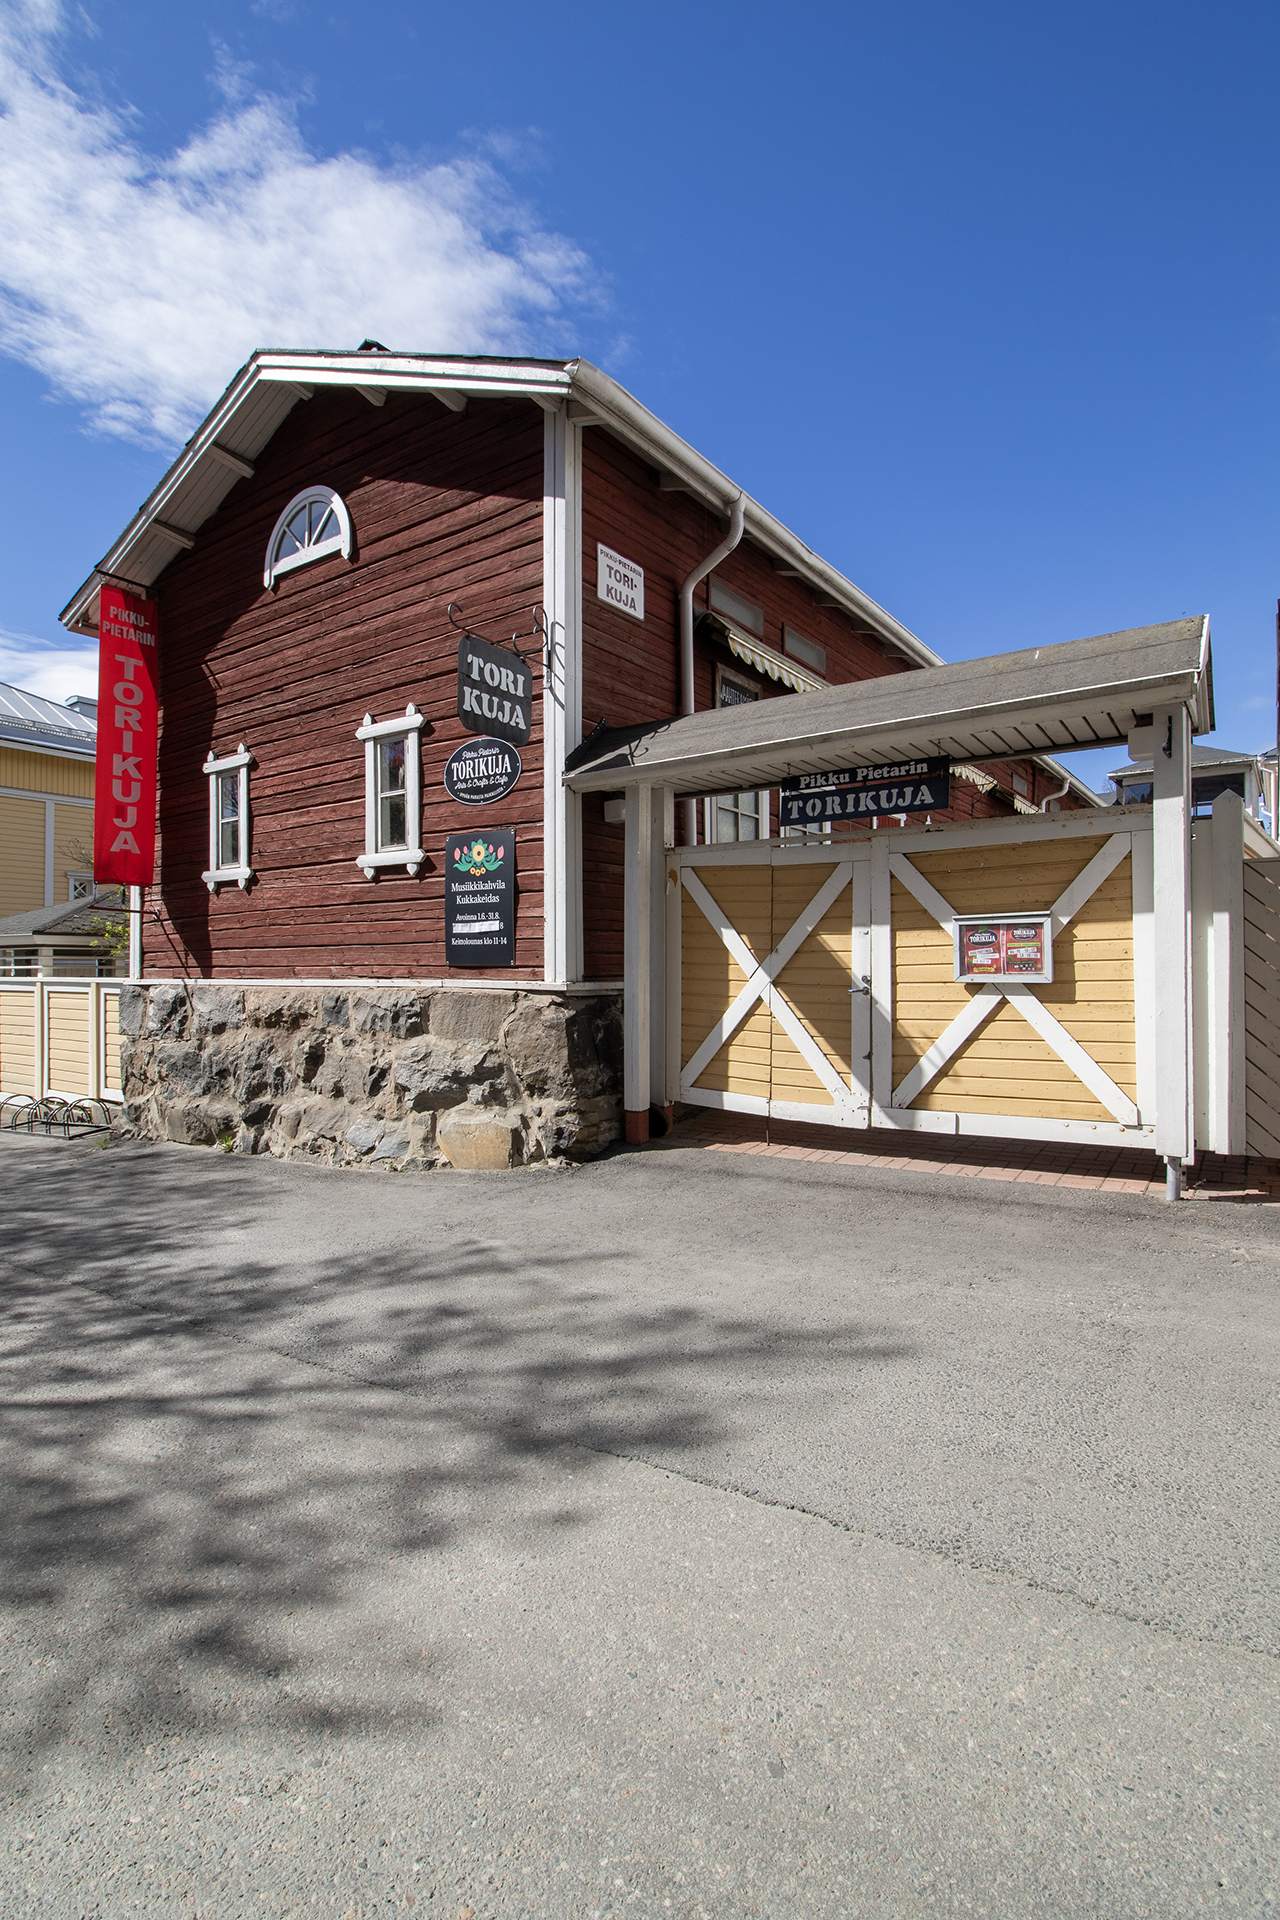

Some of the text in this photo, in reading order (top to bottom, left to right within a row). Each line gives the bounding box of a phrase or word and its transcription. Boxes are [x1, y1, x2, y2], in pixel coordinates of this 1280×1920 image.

[600, 549, 642, 577] PIKKU-PIETARIN
[606, 564, 637, 590] TORI-
[606, 584, 636, 611] KUJA
[109, 606, 149, 627] PIKKU-
[102, 620, 155, 647] PIETARIN
[467, 654, 525, 697] TORI
[463, 686, 526, 730] KUJA
[110, 654, 143, 854] TORIKUJA
[451, 754, 512, 781] TORIKUJA
[799, 761, 928, 788] Pikku Pietarin
[787, 785, 934, 819] TORIKUJA
[451, 880, 506, 892] Musiikkikahvila
[456, 894, 500, 904] Kukkakeidas
[455, 913, 477, 921] Avoinna
[483, 937, 493, 945] klo
[493, 937, 507, 945] 11-14
[970, 935, 996, 943] TORIKUJA
